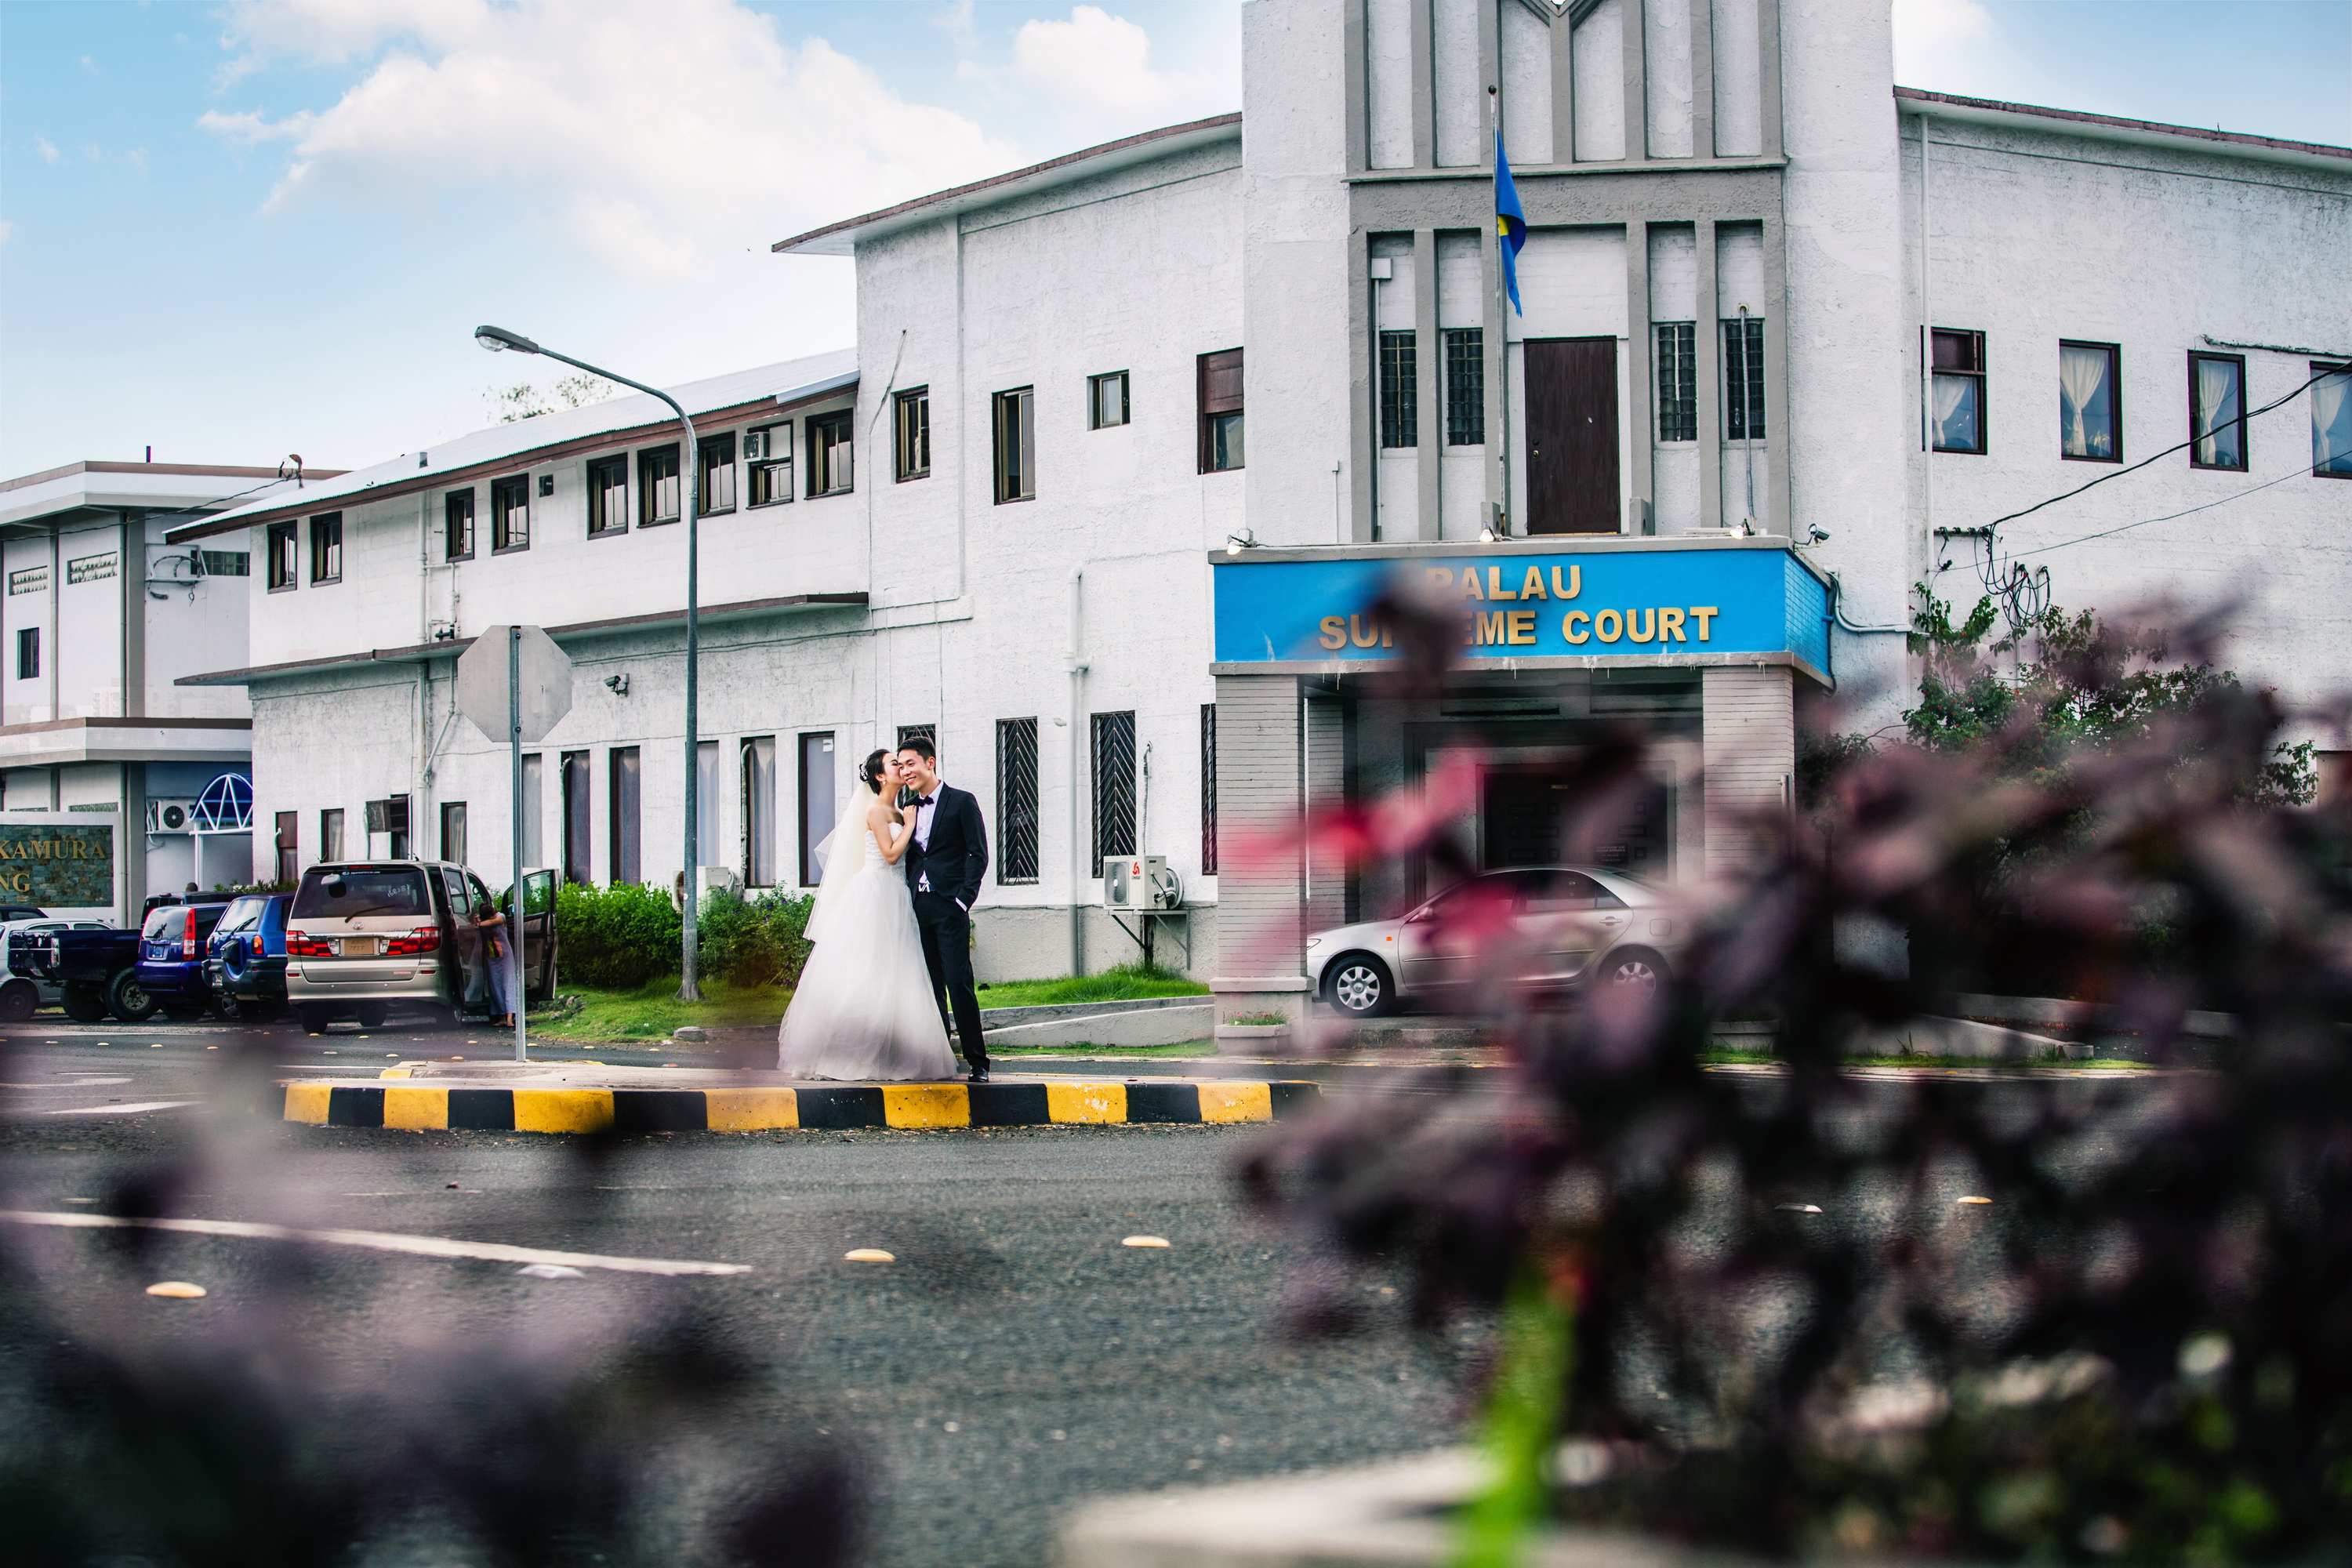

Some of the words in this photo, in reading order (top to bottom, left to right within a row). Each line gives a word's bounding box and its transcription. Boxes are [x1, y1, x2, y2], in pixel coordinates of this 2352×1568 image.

[1425, 564, 1581, 601] PALAU
[1319, 609, 1537, 650] SUEME
[1562, 606, 1719, 644] COURT
